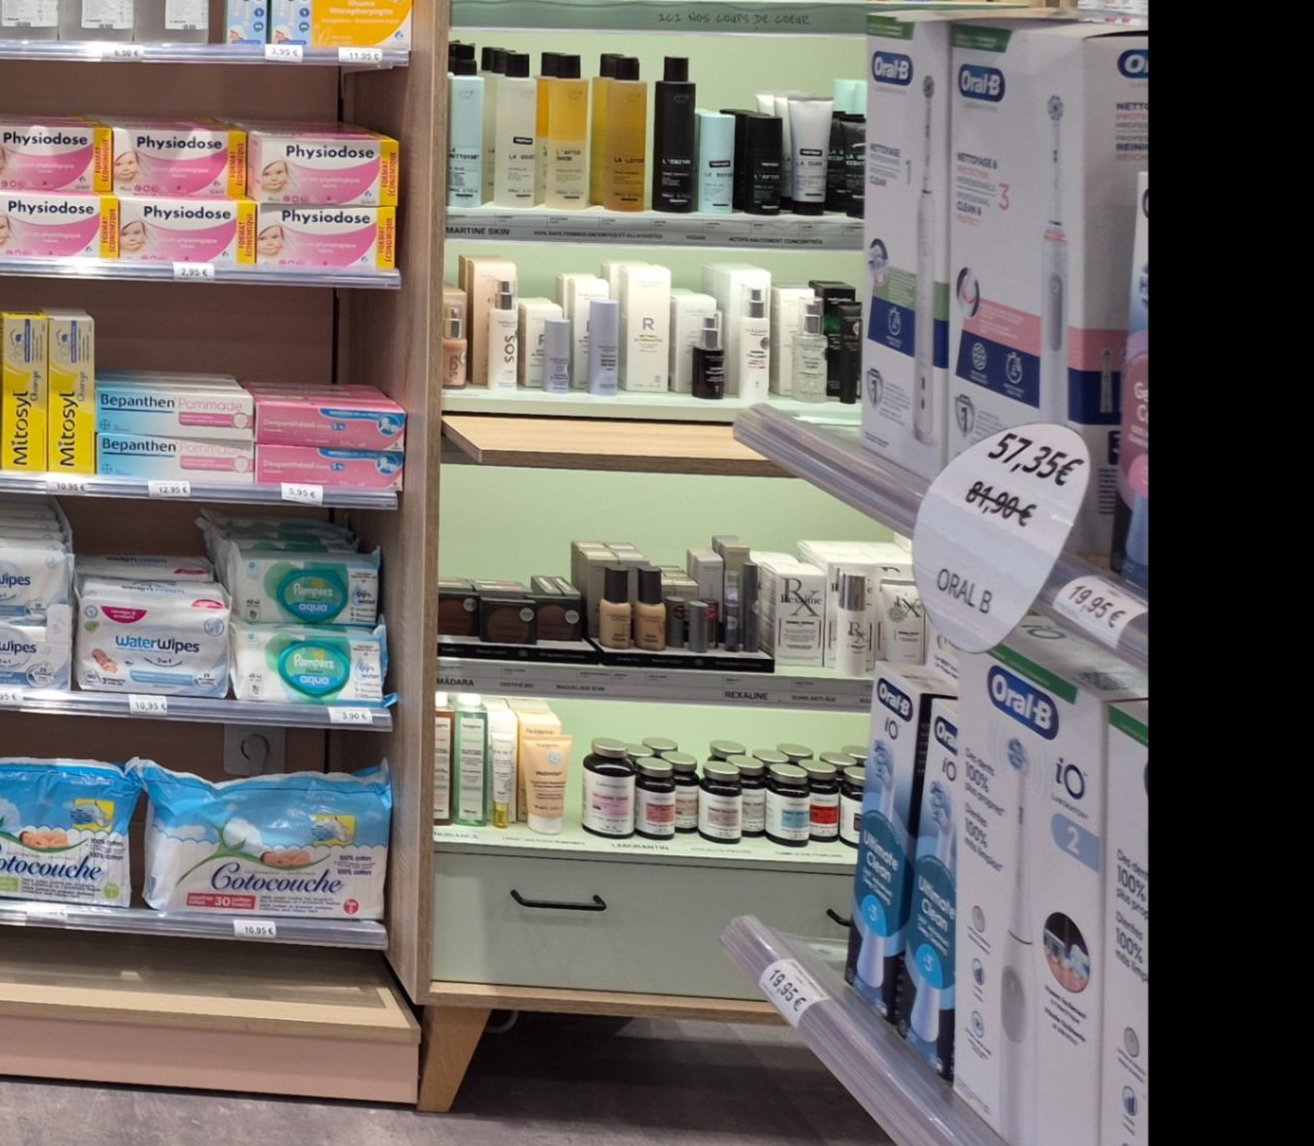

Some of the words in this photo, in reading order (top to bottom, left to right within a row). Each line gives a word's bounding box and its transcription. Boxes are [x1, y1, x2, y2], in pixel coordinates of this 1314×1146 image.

[688, 12, 710, 24] NOS
[753, 13, 771, 26] DE
[874, 55, 909, 81] Oral-B
[960, 73, 1001, 97] Oral-B
[2, 131, 89, 147] Physiodose
[136, 136, 223, 152] Physiodose
[285, 144, 375, 160] Physiodose
[8, 200, 95, 216] Physiodose
[997, 183, 1010, 211] 3
[143, 206, 232, 222] Physiodose
[504, 334, 515, 364] SOS
[100, 393, 176, 410] Bepanthen
[12, 390, 33, 466] Mitosyl
[59, 391, 79, 467] Mitosyl
[101, 437, 177, 454] Bepanthen
[987, 432, 1084, 486] 57,35€
[293, 583, 334, 598] Pampers
[936, 568, 976, 609] ORAL
[979, 589, 993, 615] B
[1067, 584, 1107, 620] 19,95
[1108, 609, 1125, 628] €
[725, 691, 768, 701] REXALINE
[877, 685, 912, 718] Oral-B
[990, 674, 1055, 731] Oral-B
[862, 831, 899, 872] Ultimate
[1065, 824, 1080, 855] 2
[210, 862, 344, 894] Cotocouche
[865, 854, 892, 884] Clean
